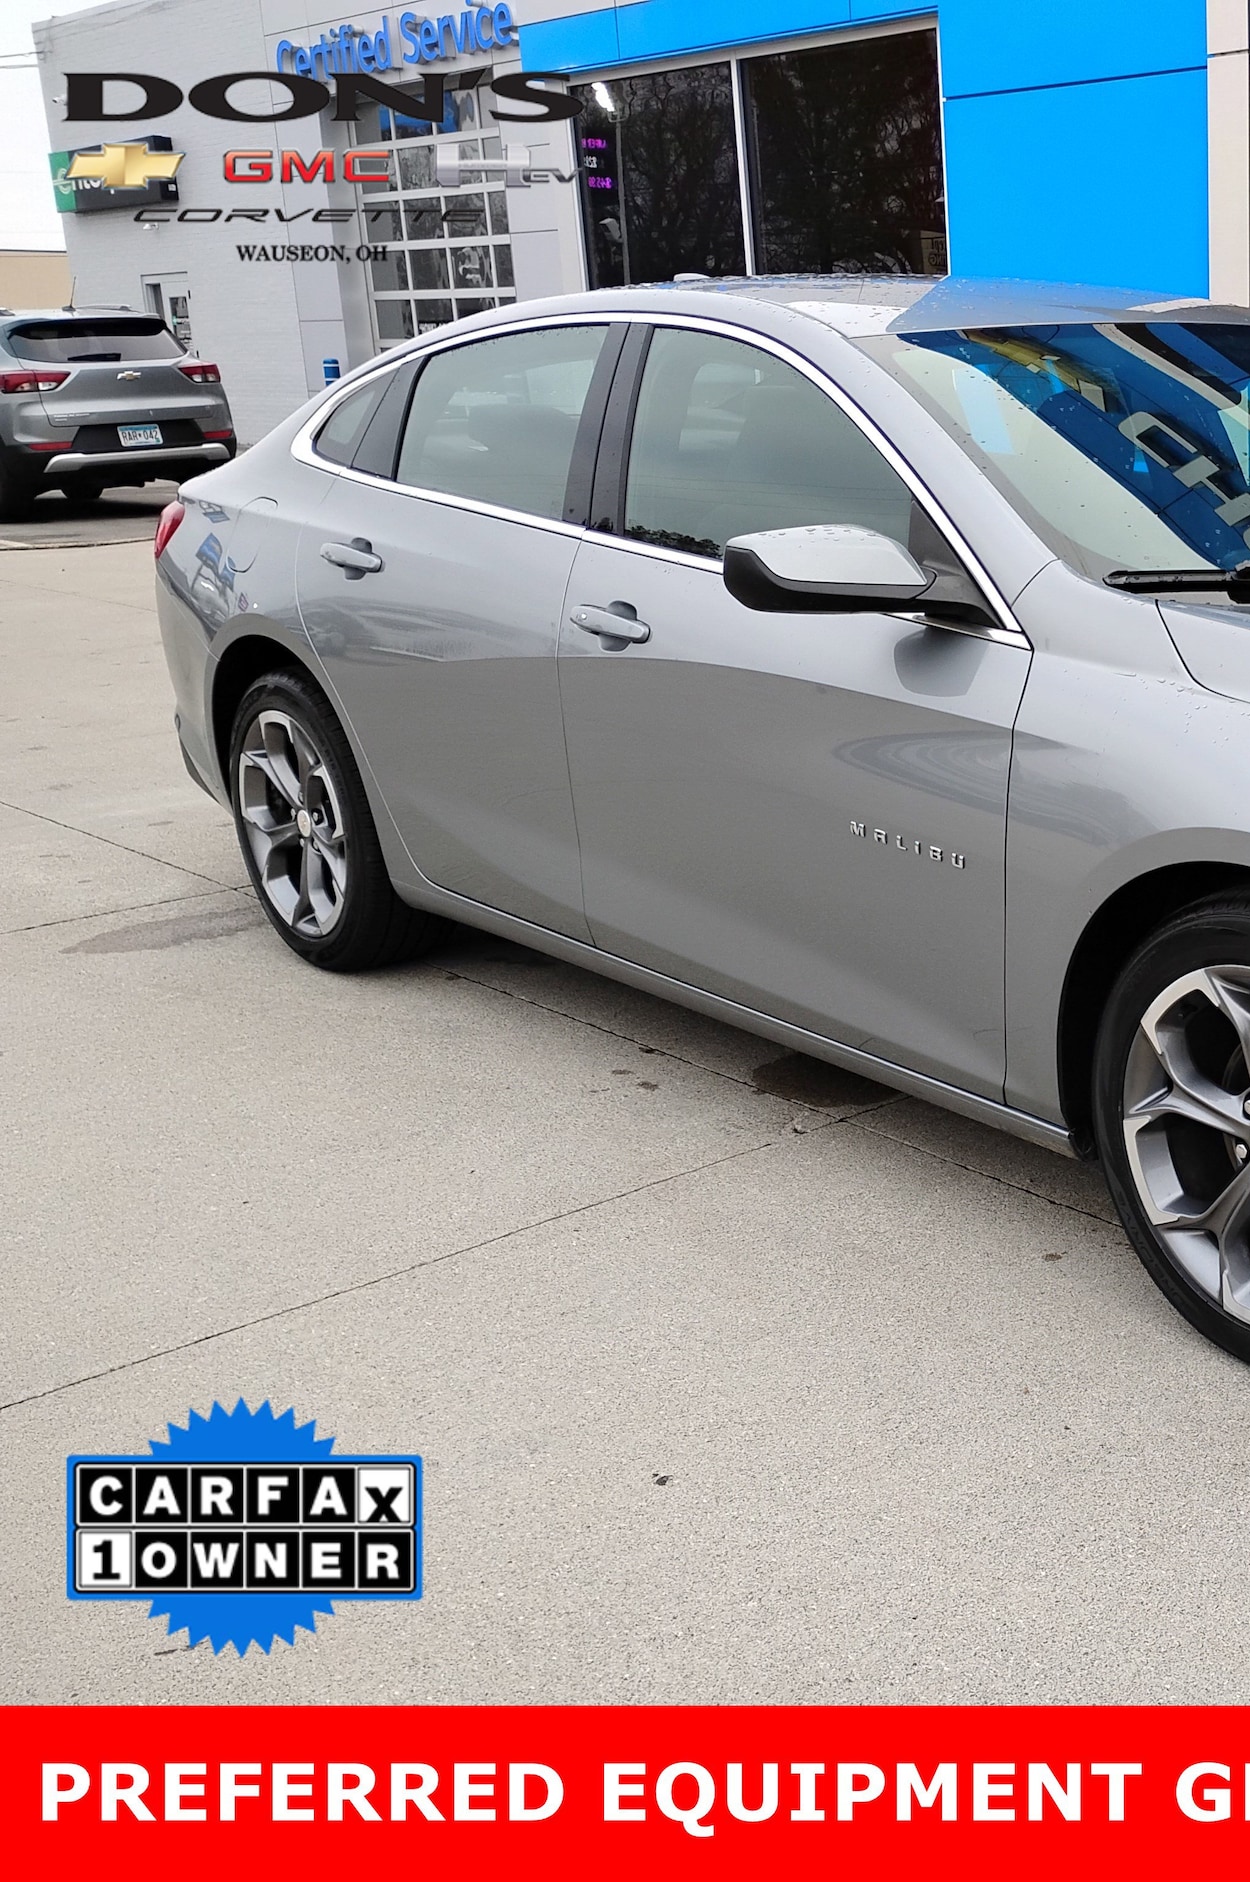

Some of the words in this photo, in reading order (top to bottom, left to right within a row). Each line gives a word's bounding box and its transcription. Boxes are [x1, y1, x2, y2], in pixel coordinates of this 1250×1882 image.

[276, 15, 393, 83] Certified
[400, 0, 514, 64] Service
[850, 820, 966, 869] MALIBU
